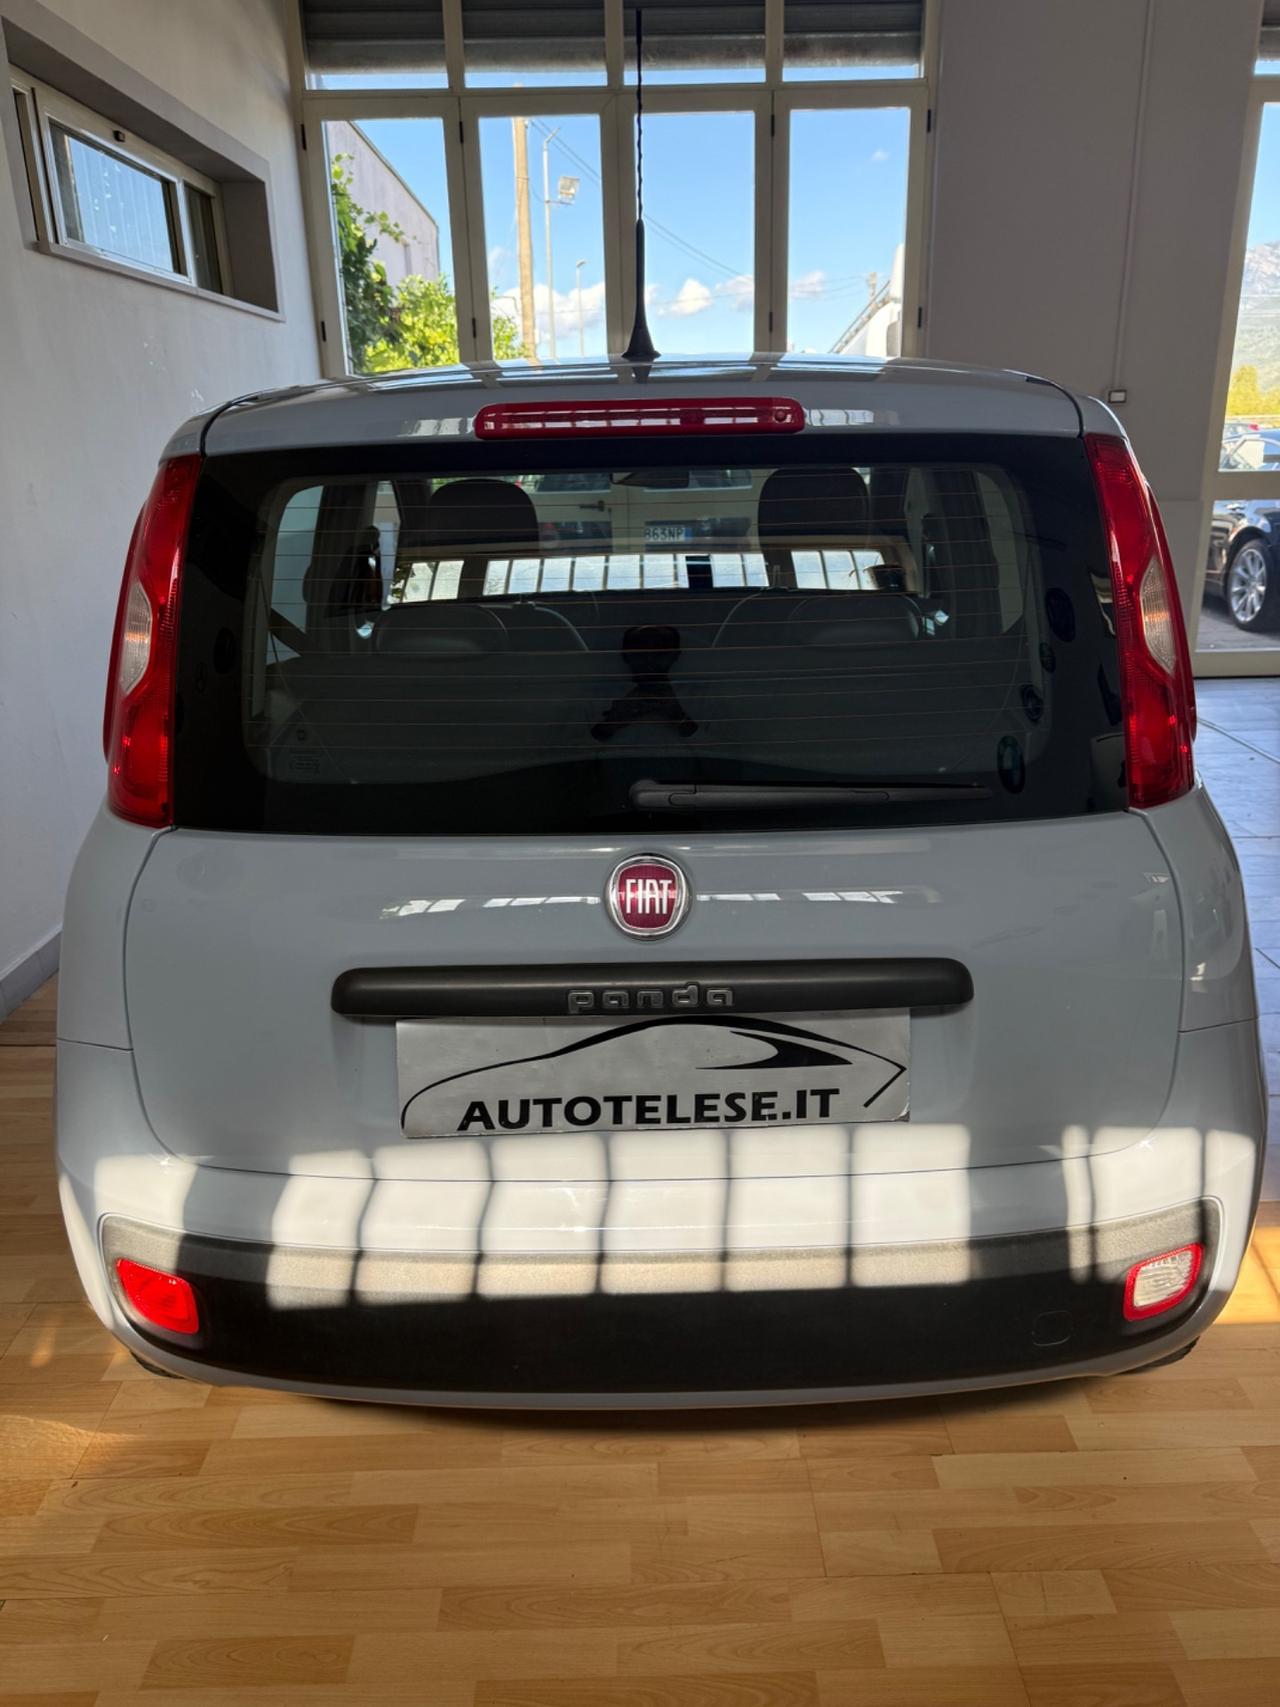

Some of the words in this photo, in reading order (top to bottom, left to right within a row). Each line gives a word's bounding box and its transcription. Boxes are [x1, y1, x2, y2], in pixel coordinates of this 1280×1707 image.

[626, 879, 673, 914] FIAT
[567, 982, 734, 1013] panda
[457, 1088, 840, 1131] AUTOTELESE.IT
